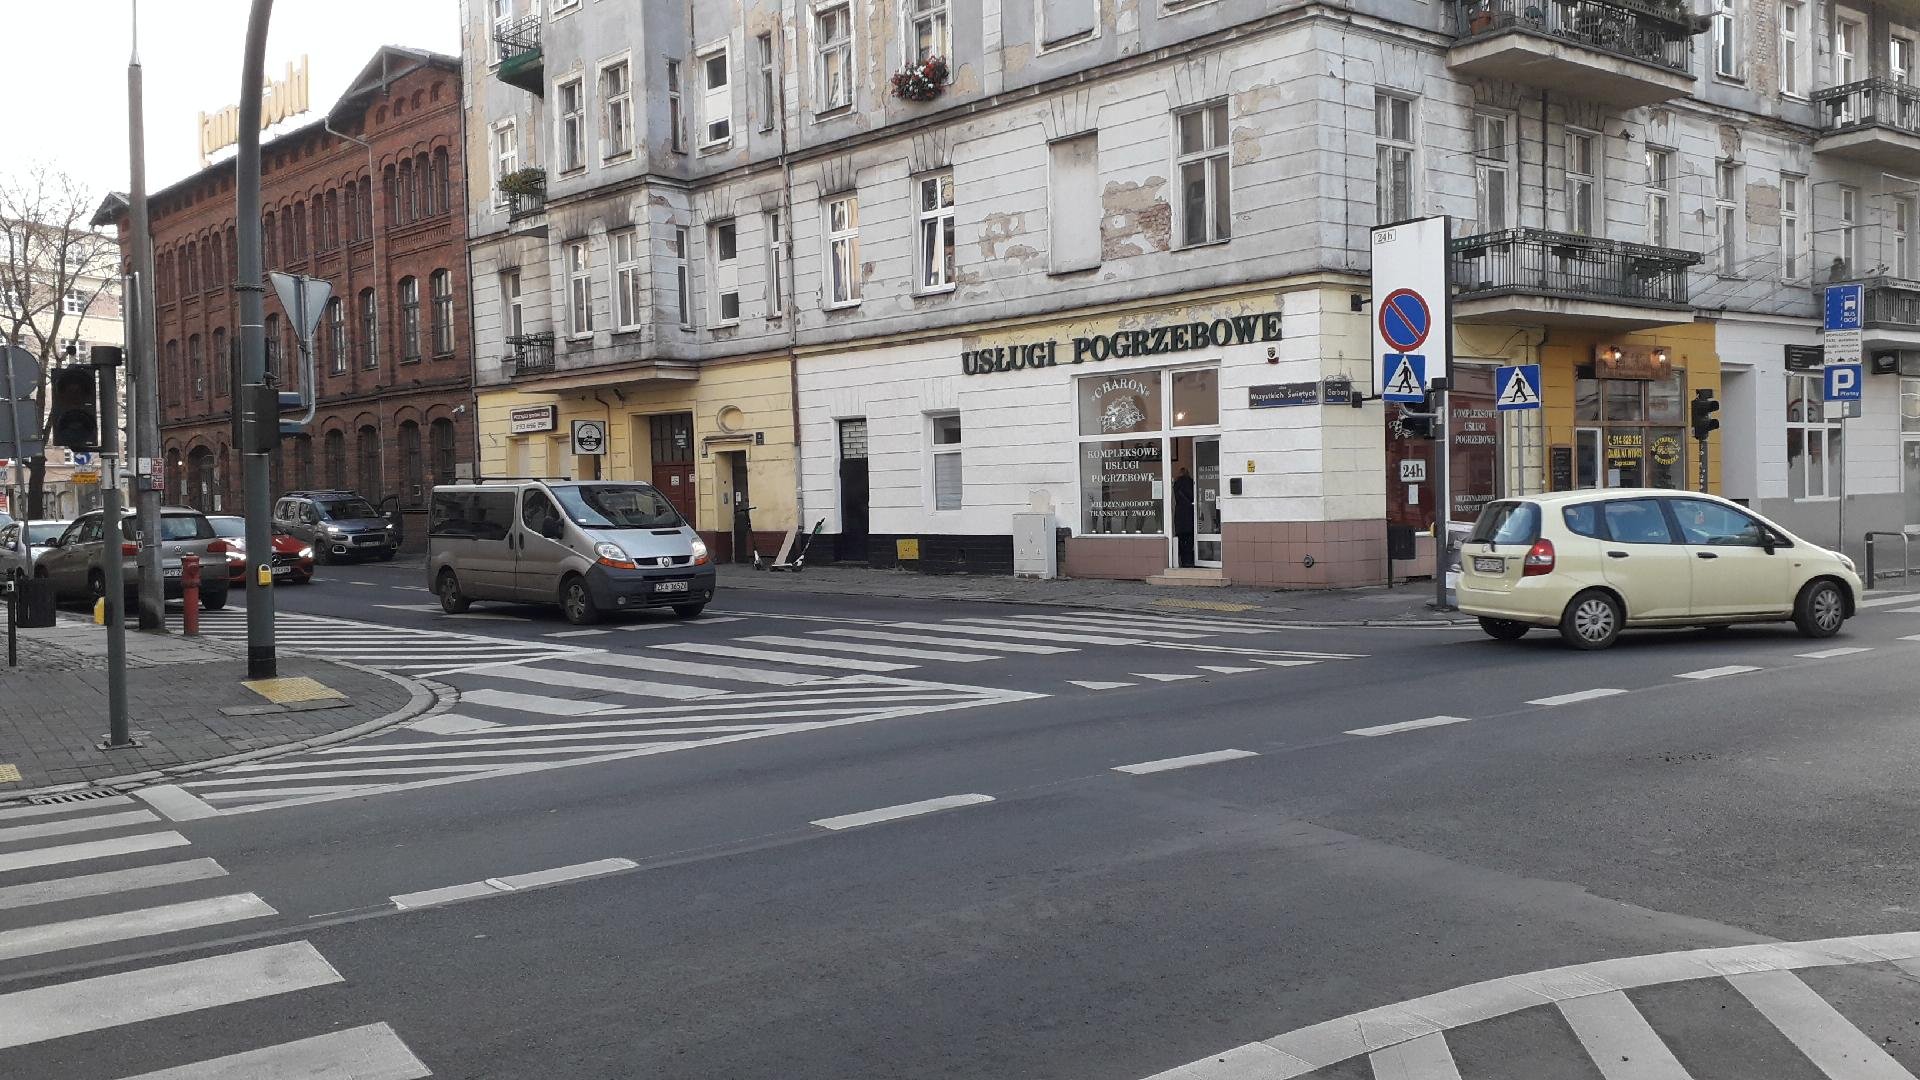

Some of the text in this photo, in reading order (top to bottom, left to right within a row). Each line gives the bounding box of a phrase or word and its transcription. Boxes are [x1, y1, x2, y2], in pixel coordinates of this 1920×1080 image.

[962, 342, 1057, 376] USŁUGI
[1072, 312, 1283, 363] POGRZEBOWE
[1831, 368, 1855, 397] P
[1250, 391, 1284, 401] Wszystkich
[1455, 434, 1496, 444] POGRZEBOWE
[1087, 447, 1158, 459] KOMPLEKSOWE
[1104, 461, 1140, 470] USŁUGI
[1402, 463, 1424, 478] 24h
[1091, 472, 1155, 483] POGRZEBOWE
